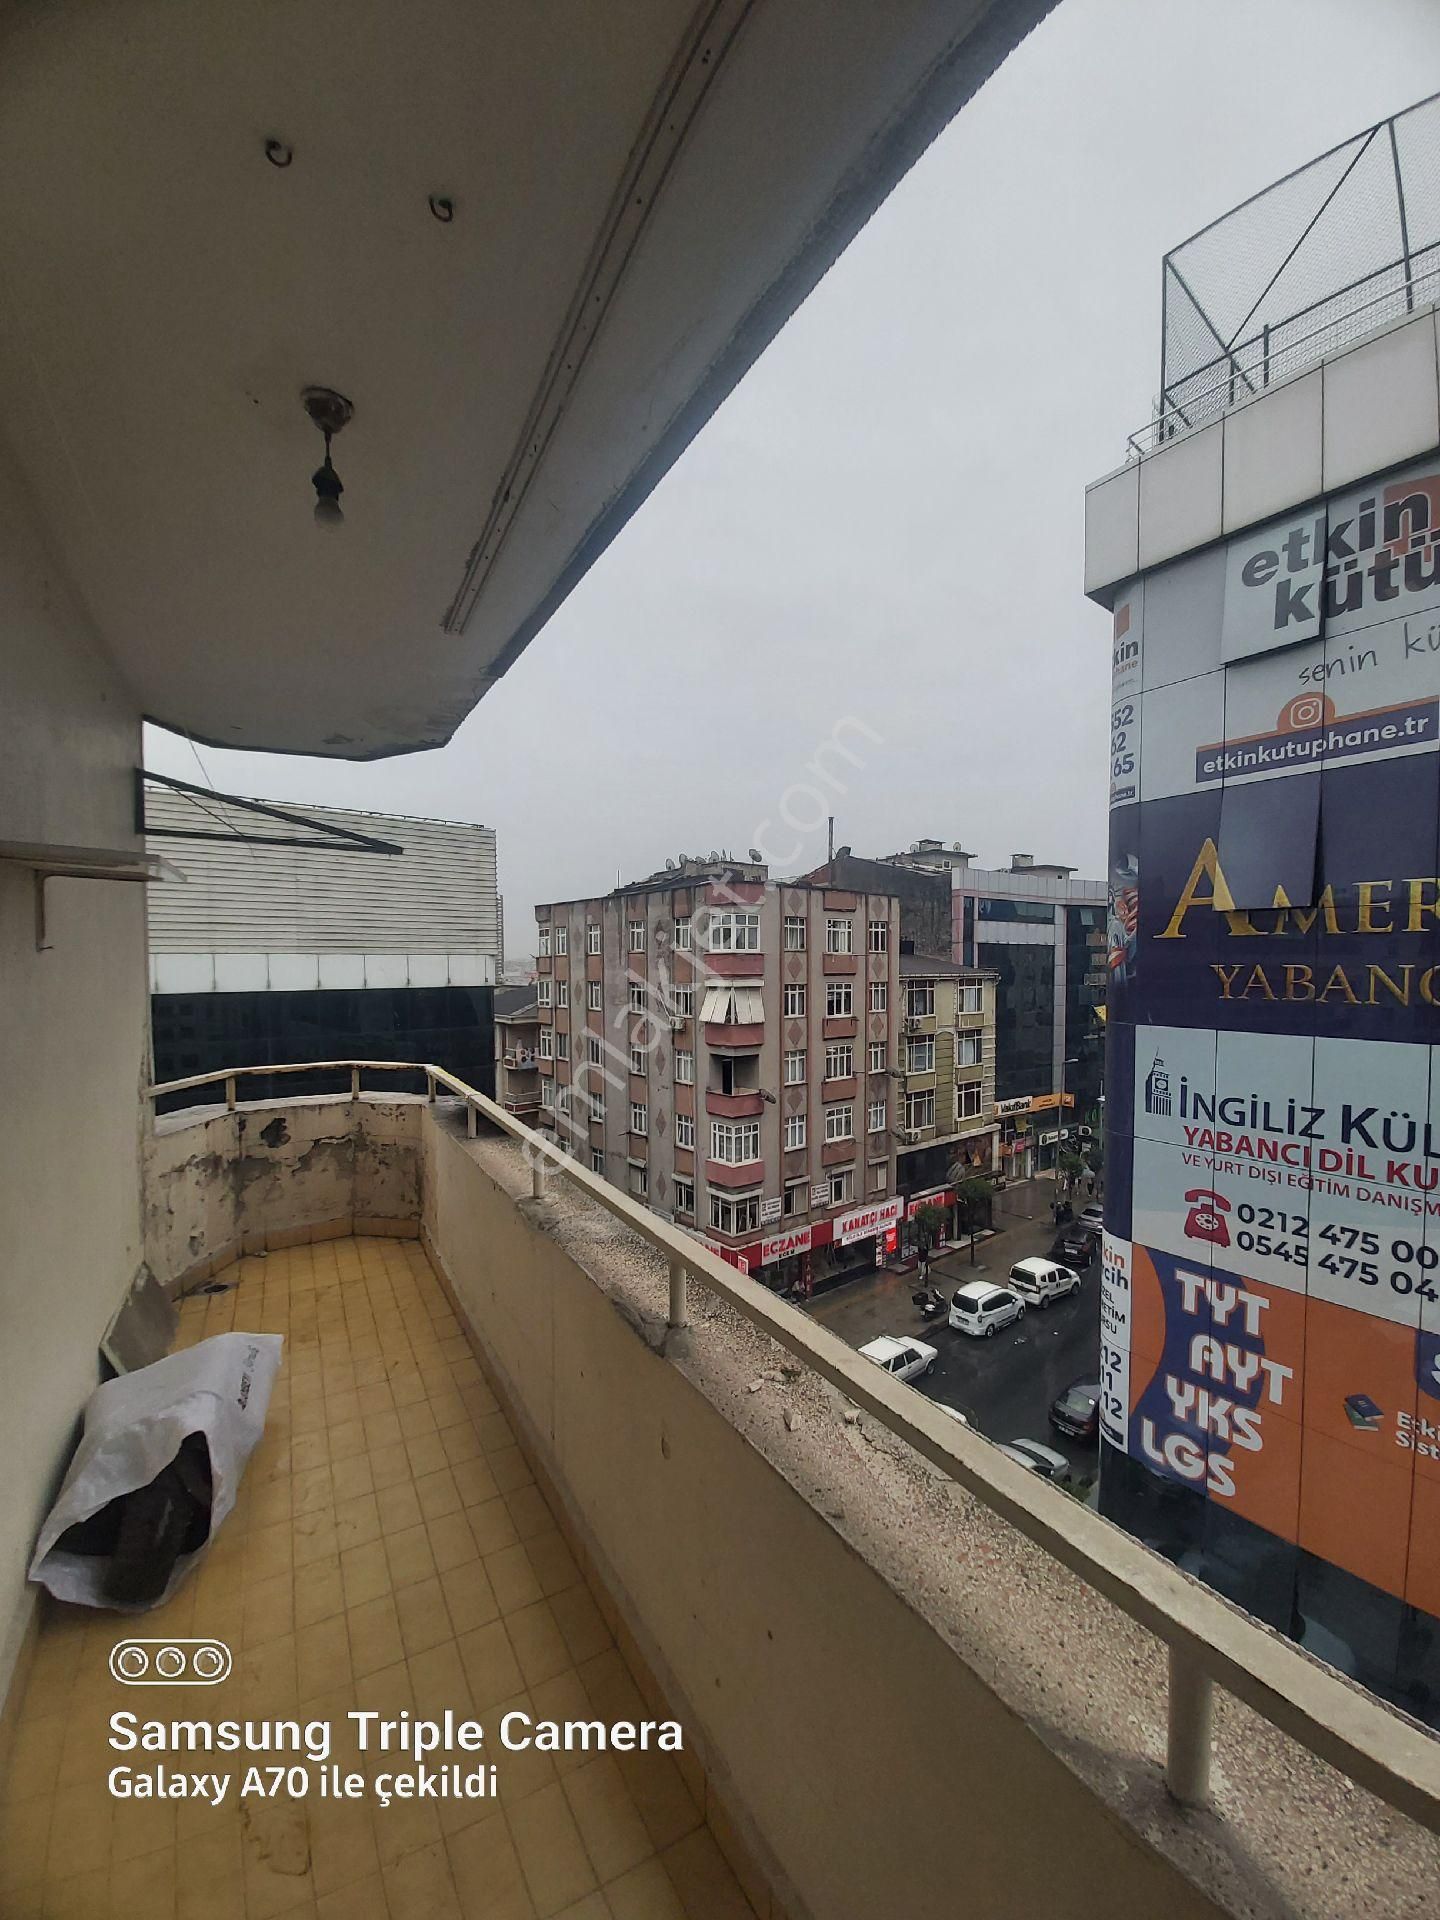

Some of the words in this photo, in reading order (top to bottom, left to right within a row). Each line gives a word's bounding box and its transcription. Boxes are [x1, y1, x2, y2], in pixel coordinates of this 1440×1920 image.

[1241, 493, 1430, 588] etkin
[1298, 645, 1379, 686] senin
[1111, 704, 1134, 732] 52
[1202, 714, 1430, 774] etkinkutuphane.tr
[1179, 1075, 1325, 1141] İNGİLİZ
[1181, 1152, 1201, 1167] VE
[1203, 1157, 1245, 1177] YURT
[1249, 1165, 1282, 1187] DIŞI
[1287, 1173, 1351, 1199] EĞİTİM
[1182, 1124, 1311, 1170] YABANCI
[1319, 1147, 1376, 1181] DİL
[1386, 1159, 1440, 1192] KU
[763, 1231, 810, 1258] ECZANE
[1236, 1203, 1309, 1239] 0212
[1318, 1223, 1380, 1257] 475
[1391, 1239, 1439, 1270] 00
[1236, 1230, 1308, 1267] 0545
[1317, 1253, 1379, 1286] 475
[1390, 1270, 1439, 1303] 04
[1102, 1264, 1128, 1291] cih
[1174, 1267, 1270, 1337] TYT
[1188, 1333, 1294, 1406] AYT
[1165, 1373, 1264, 1453] YKS
[1141, 1416, 1236, 1497] LGS
